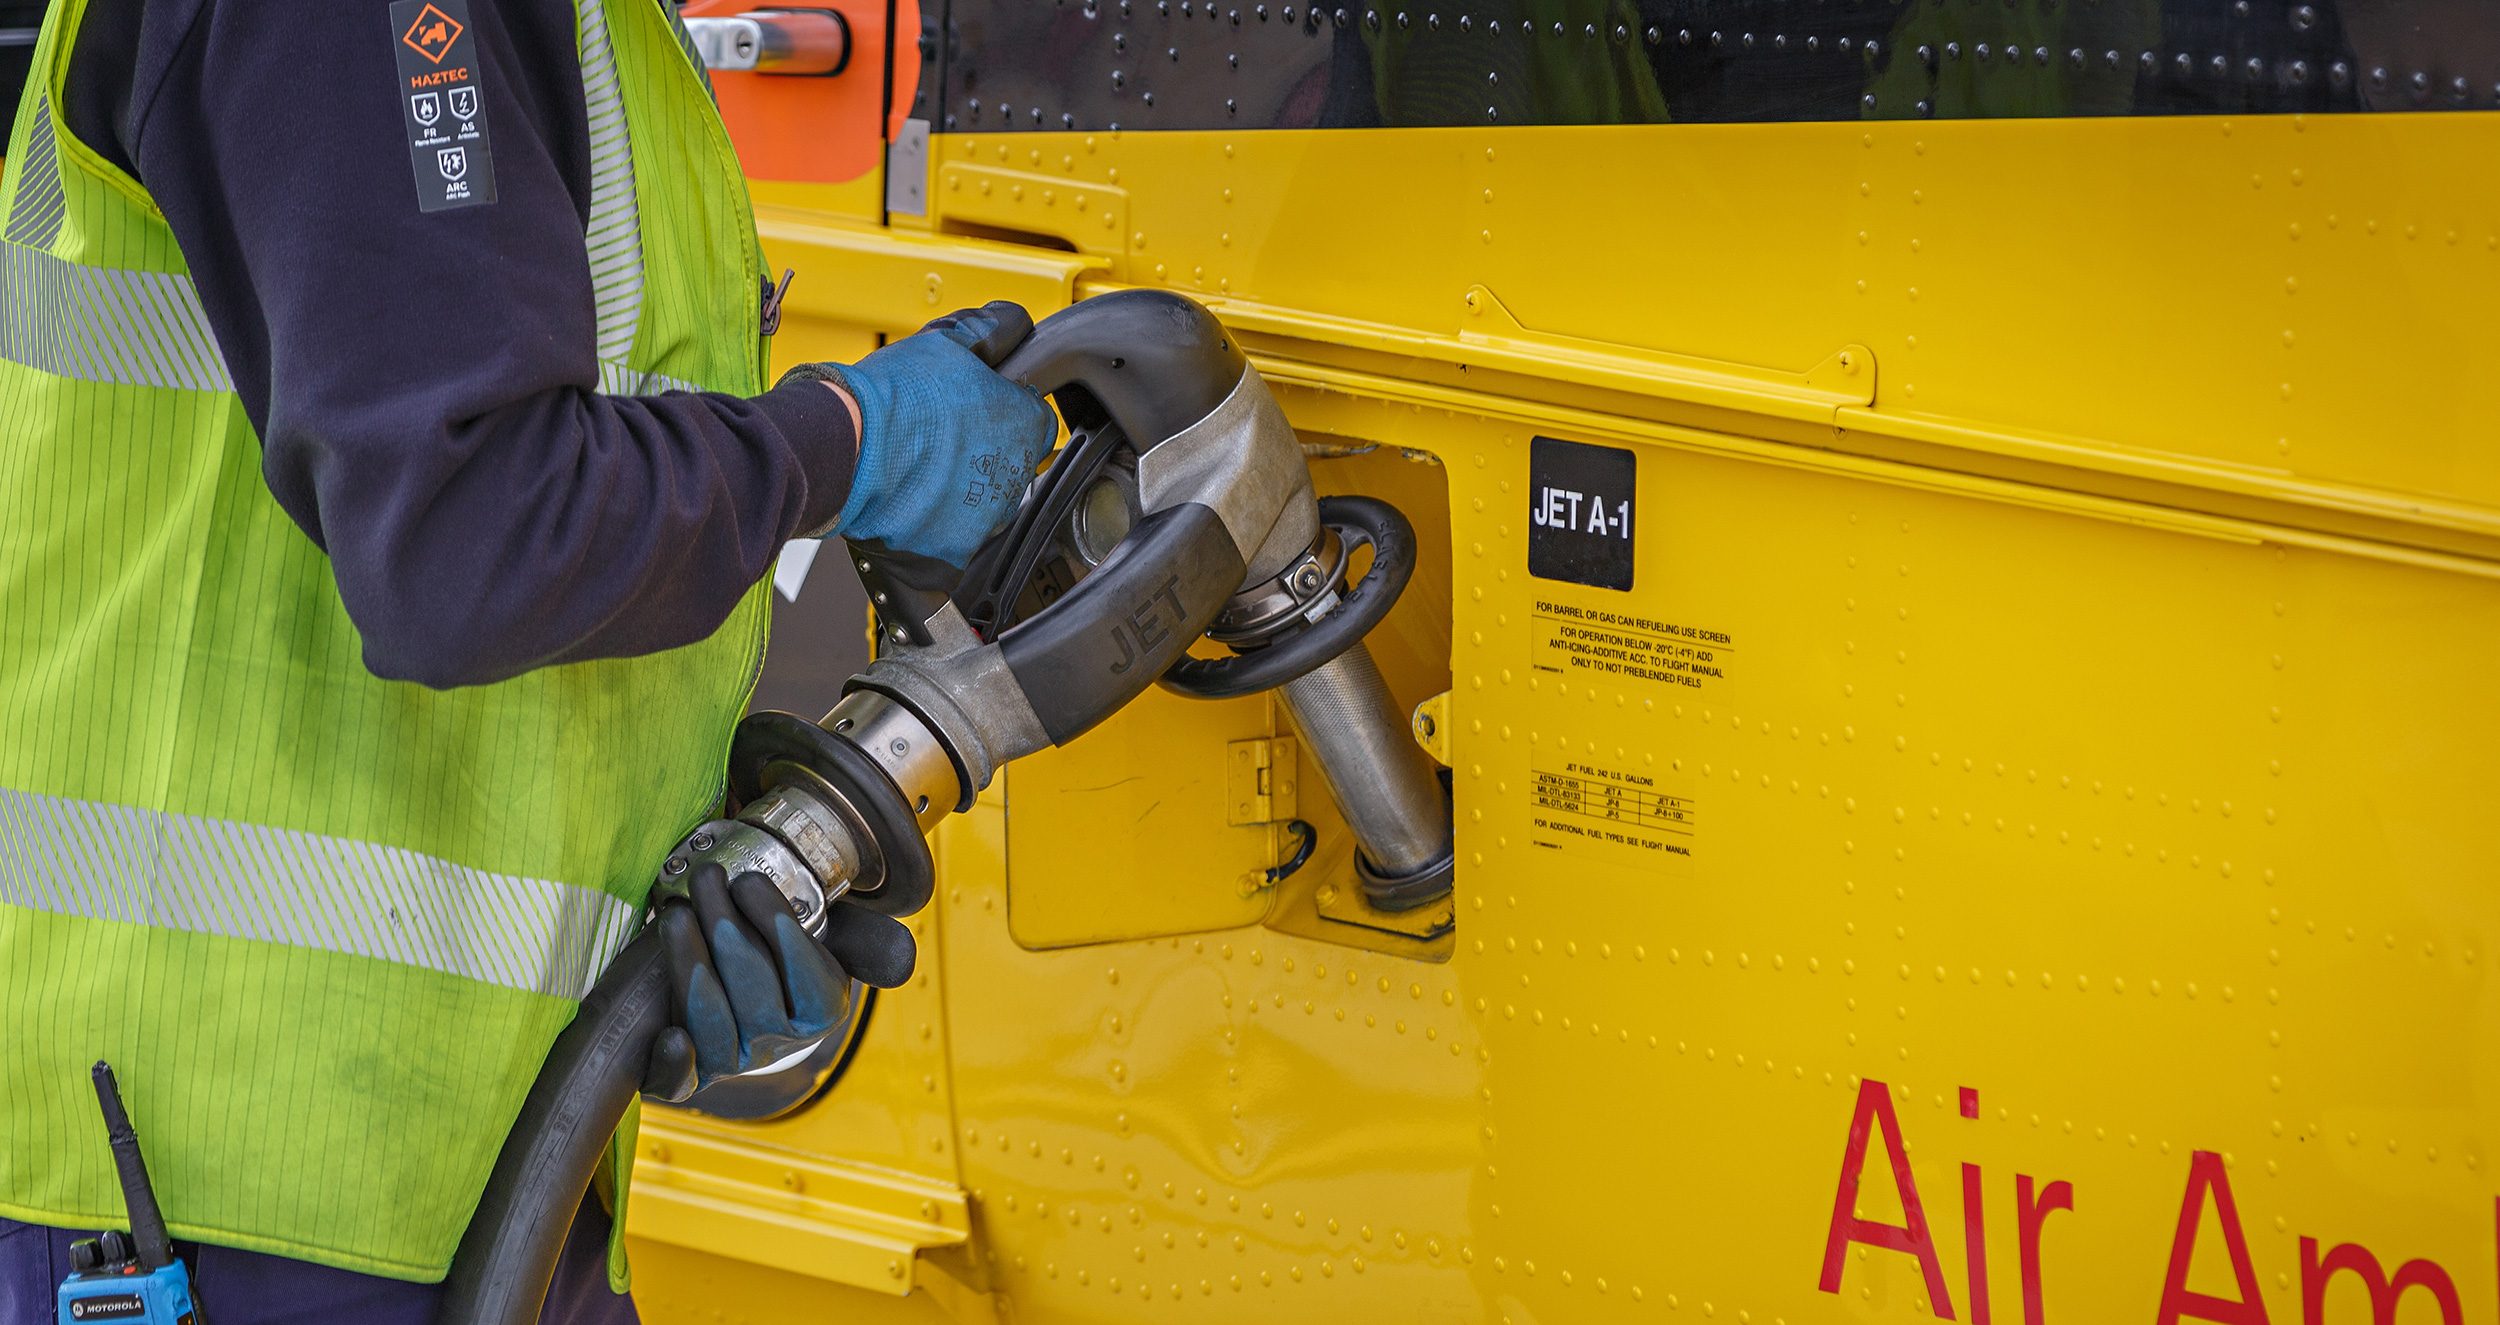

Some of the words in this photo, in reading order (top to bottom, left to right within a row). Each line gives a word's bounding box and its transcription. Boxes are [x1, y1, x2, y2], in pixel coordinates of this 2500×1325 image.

[411, 68, 468, 88] HAZTEC
[424, 127, 437, 139] FR
[461, 121, 475, 133] AS
[446, 181, 468, 193] ARC
[1534, 486, 1583, 531] JET
[1587, 495, 1630, 539] A-1
[1110, 574, 1188, 675] JET
[1536, 600, 1553, 613] FOR
[1553, 604, 1585, 619] BARREL
[1585, 609, 1598, 621] OR
[1599, 611, 1617, 624] GAS
[1617, 615, 1635, 627] CAN
[1635, 618, 1680, 636] REFUELING
[1681, 626, 1697, 639] USE
[1698, 629, 1731, 645] SCREEN
[1548, 638, 1628, 661] ANTI-ICING-ADDITIVE
[1629, 652, 1648, 665] ACC.
[1649, 655, 1661, 667] TO
[1662, 658, 1690, 672] FLIGHT
[1691, 663, 1724, 679] MANUAL
[1560, 626, 1577, 638] FOR
[1577, 629, 1623, 646] OPERATION
[1624, 637, 1653, 651] BELOW
[1654, 643, 1674, 656] -20°C
[1696, 650, 1714, 663] ADD
[1570, 656, 1592, 669] ONLY
[1593, 659, 1605, 671] TO
[1605, 662, 1622, 674] NOT
[1623, 665, 1676, 684] PREBLENDED
[1676, 674, 1702, 689] FUELS
[1566, 763, 1577, 772] JET
[1579, 765, 1595, 776] FUEL
[1597, 768, 1609, 778] 242
[1625, 773, 1654, 787] GALLONS
[1604, 787, 1616, 796] JET
[1617, 789, 1622, 797] A
[1657, 797, 1669, 805] JET
[1670, 799, 1680, 808] A-1
[1534, 818, 1548, 828] FOR
[1549, 821, 1585, 837] ADDITIONAL
[1587, 828, 1603, 840] FUEL
[1605, 832, 1625, 844] TYPES
[1626, 836, 1639, 847] SEE
[1641, 839, 1663, 851] FLIGHT
[1665, 844, 1691, 857] MANUAL
[1818, 1077, 2074, 1325] Air
[2156, 1149, 2500, 1325] Am
[86, 1301, 142, 1314] MOTOROLA
